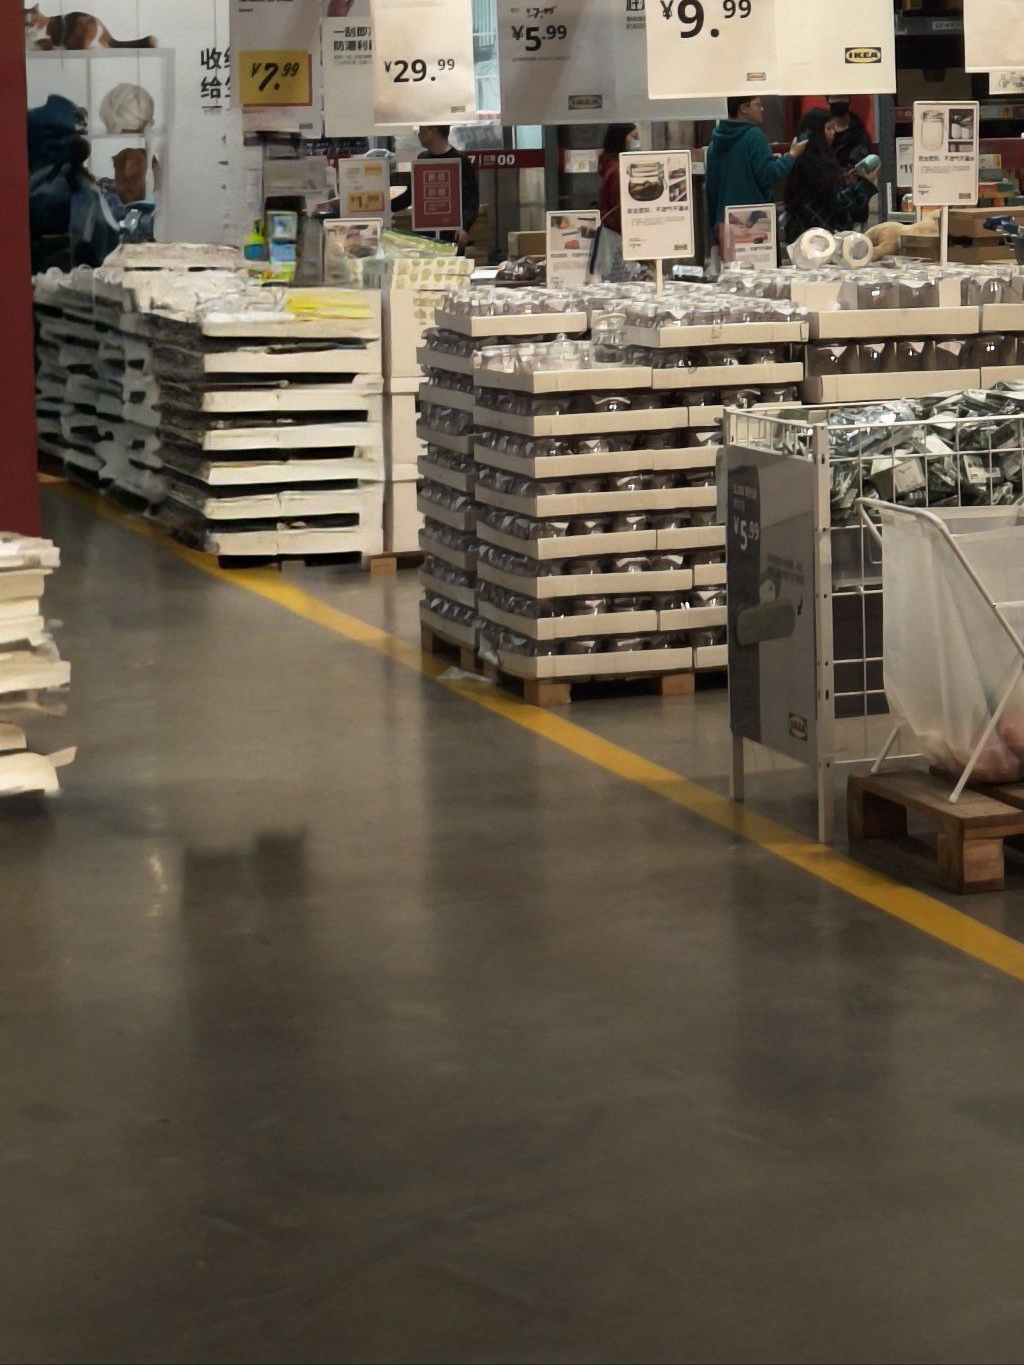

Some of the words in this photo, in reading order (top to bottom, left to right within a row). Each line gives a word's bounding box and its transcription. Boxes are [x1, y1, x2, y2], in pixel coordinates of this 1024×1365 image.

[511, 25, 567, 51] ¥5.99
[251, 62, 300, 91] ¥7.99
[384, 58, 455, 83] ¥29.99
[498, 155, 516, 166] 00
